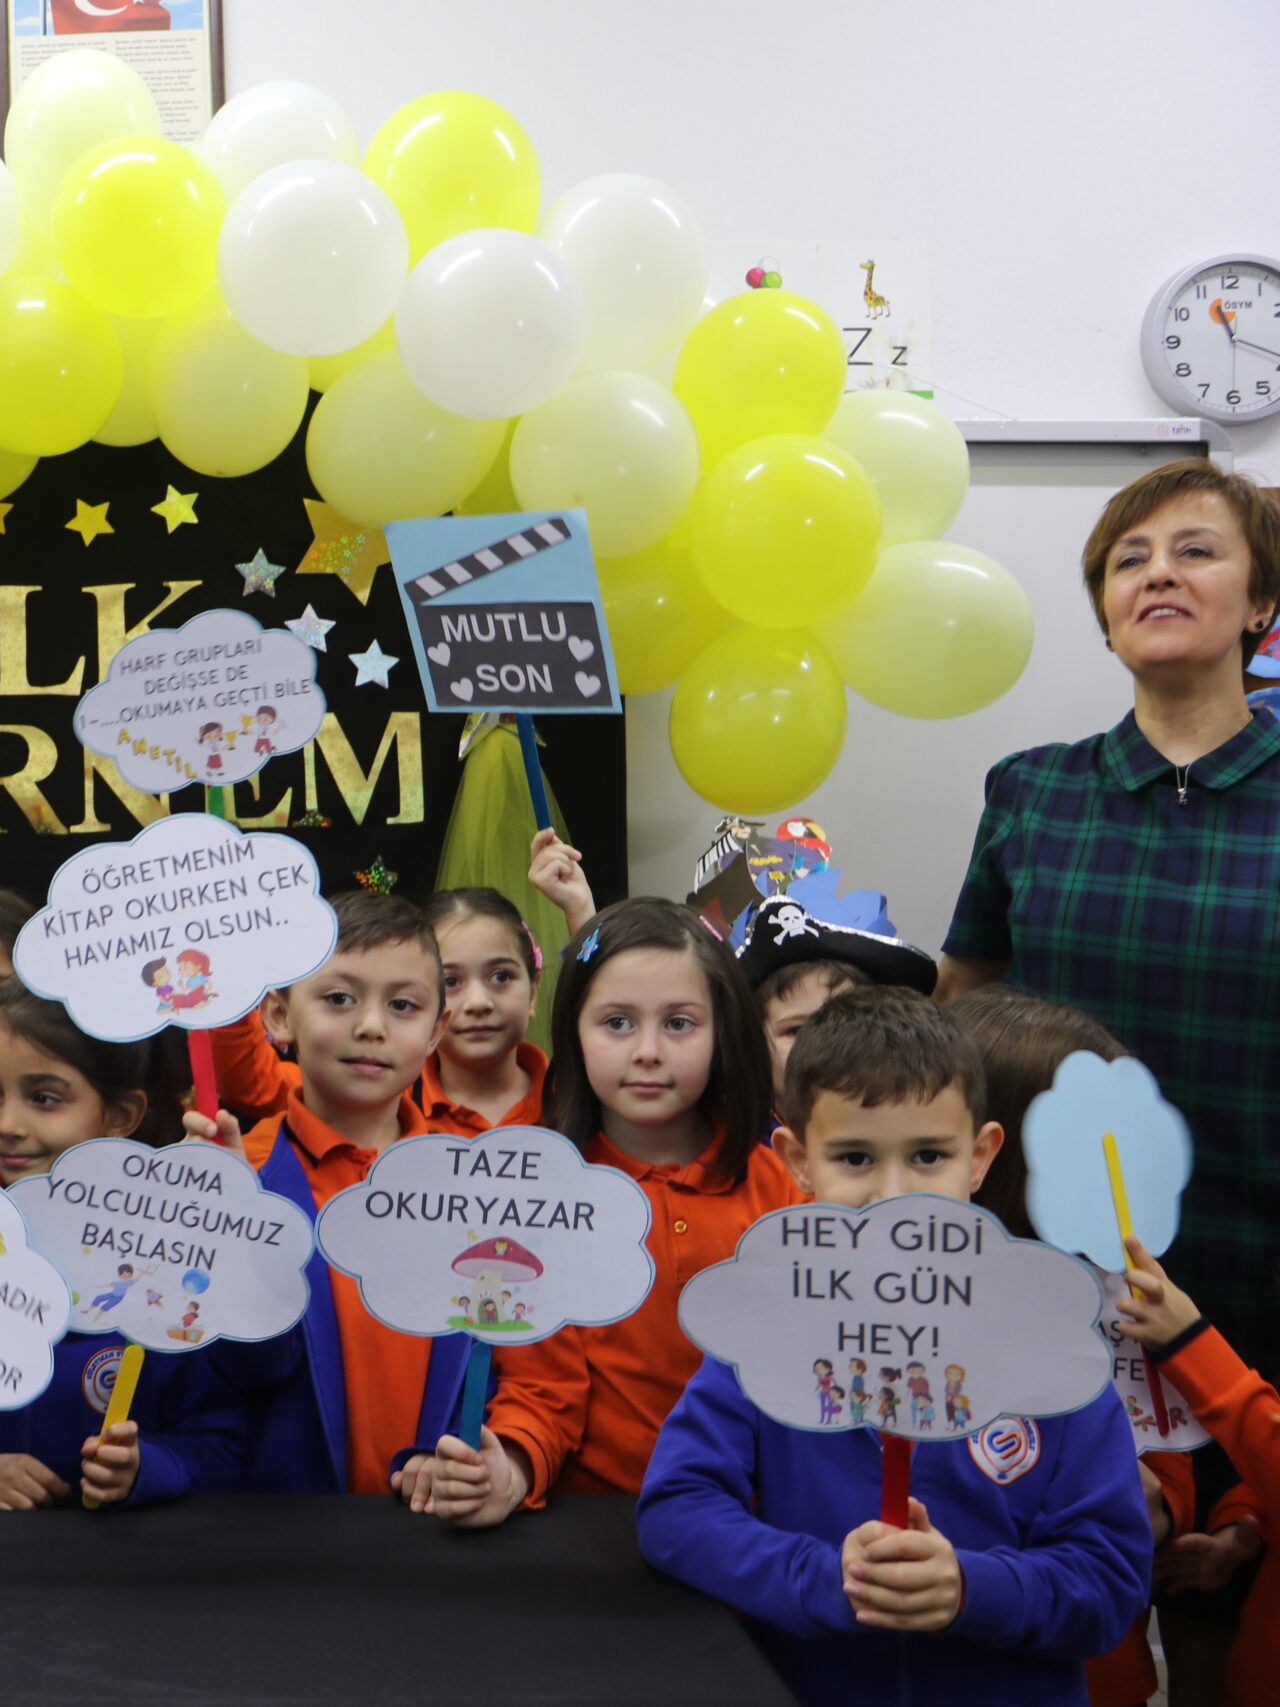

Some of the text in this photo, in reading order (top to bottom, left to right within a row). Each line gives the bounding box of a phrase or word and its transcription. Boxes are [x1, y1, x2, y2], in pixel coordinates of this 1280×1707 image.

[1196, 285, 1207, 299] 11
[1221, 275, 1239, 290] 12
[1174, 307, 1190, 322] 10
[1165, 335, 1181, 350] 9
[1175, 362, 1192, 377] 8
[1197, 383, 1211, 398] 7
[1225, 390, 1241, 405] 6
[1255, 381, 1271, 396] 5
[440, 611, 567, 643] MUTLU
[120, 638, 262, 676] HARF GRUPLARI
[144, 665, 249, 696] DEĞİŞSE DE
[213, 684, 268, 708] GEÇTİ
[274, 678, 311, 699] BİLE
[475, 664, 553, 694] SON
[81, 839, 256, 895] ÖĞRETMENİM
[43, 864, 309, 939] KİTAP OKURKEN ÇEK
[64, 907, 290, 970] HAVAMIZ OLSUN..
[123, 1154, 223, 1195] OKUMA
[446, 1147, 542, 1181] TAZE
[47, 1176, 285, 1246] YOLCULUĞUMUZ
[364, 1190, 596, 1232] OKURYAZAR
[81, 1222, 217, 1271] BAŞLASIN
[781, 1214, 984, 1256] HEY GİDİ
[791, 1260, 973, 1307] İLK GÜN
[837, 1321, 940, 1358] HEY!
